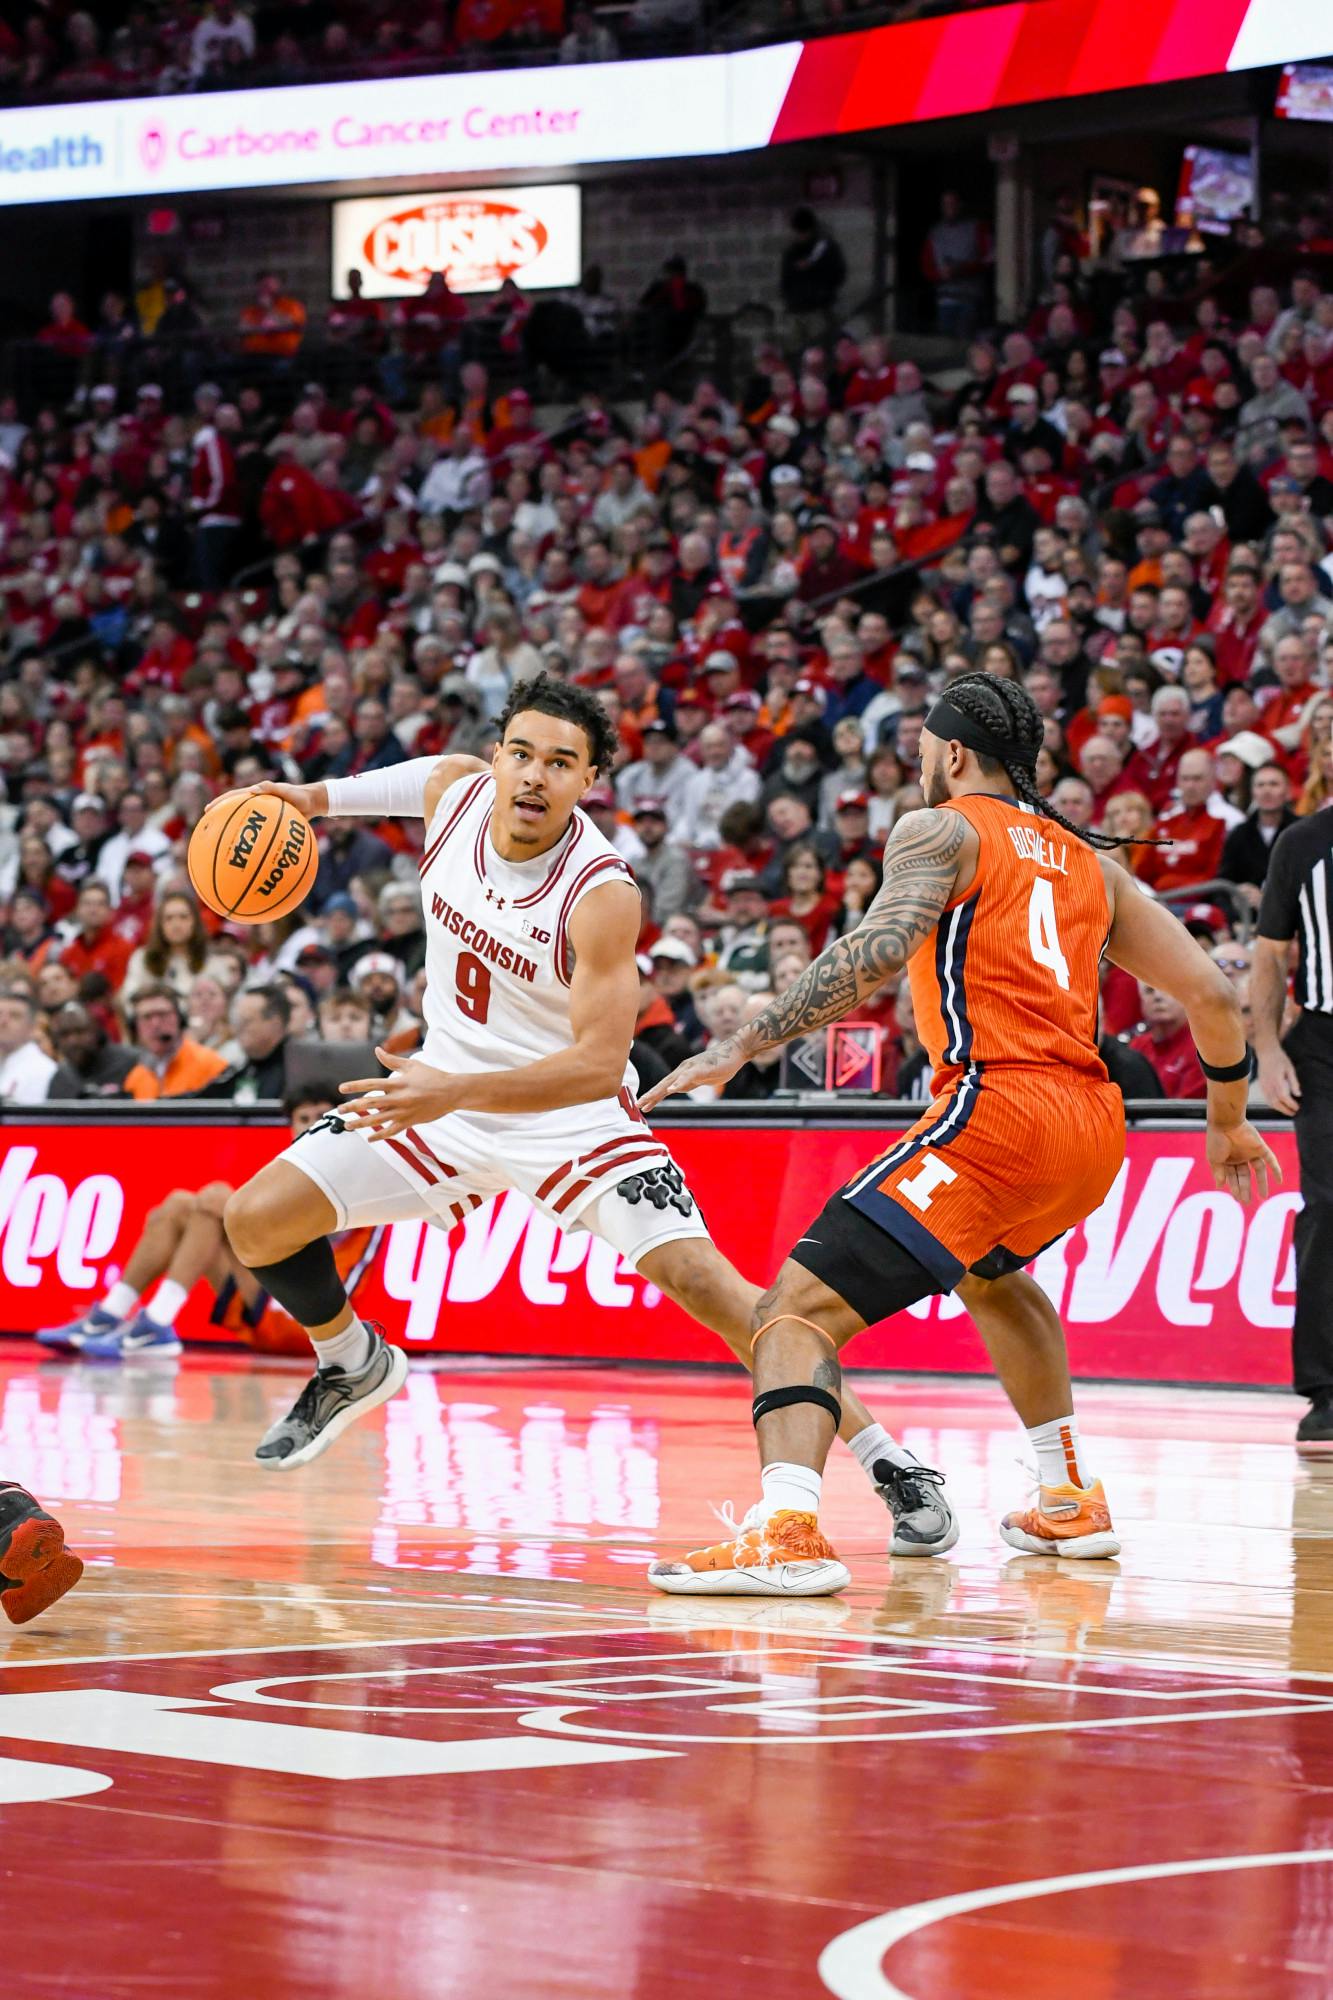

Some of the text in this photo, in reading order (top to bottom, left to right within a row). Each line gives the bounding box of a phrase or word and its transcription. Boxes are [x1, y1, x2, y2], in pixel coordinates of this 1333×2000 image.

[0, 134, 104, 172] ealth
[177, 106, 580, 161] Carbone Cancer Center
[229, 810, 267, 869] NCAA
[257, 819, 306, 896] Wilson
[1007, 826, 1068, 875] BOSWELL
[431, 892, 538, 983] WISCONSIN
[1028, 876, 1070, 991] 4
[455, 951, 491, 1025] 9
